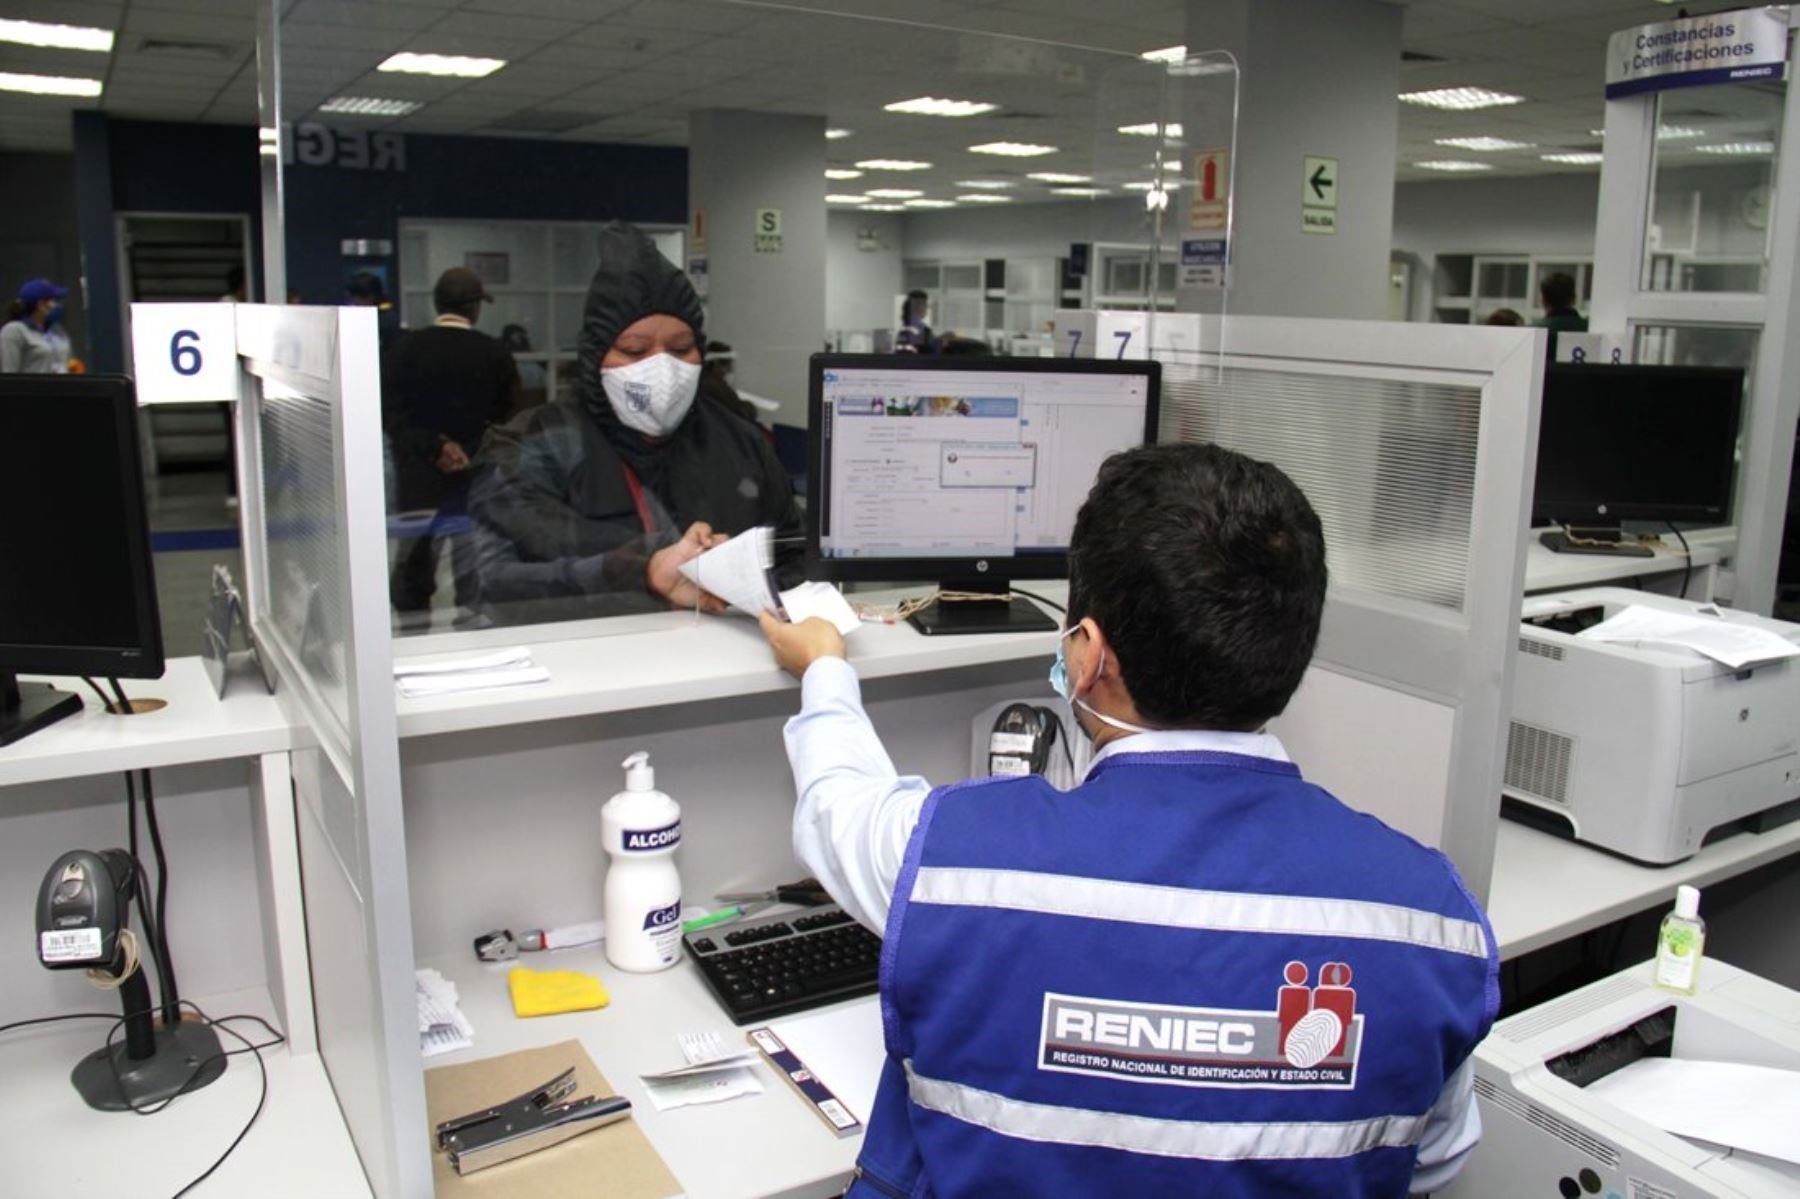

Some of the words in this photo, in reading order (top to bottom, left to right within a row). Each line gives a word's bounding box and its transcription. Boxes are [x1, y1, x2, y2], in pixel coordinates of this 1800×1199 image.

[1636, 23, 1736, 49] Constancias
[1623, 60, 1630, 75] y
[1633, 42, 1755, 70] Certificaciones
[762, 212, 776, 232] S
[170, 329, 203, 376] 6
[1067, 330, 1083, 359] 7
[1113, 331, 1132, 360] 7
[653, 906, 676, 924] Gel
[1055, 1006, 1255, 1055] RENIEC
[1053, 1050, 1109, 1067] REGISTRO
[1111, 1059, 1167, 1074] NACIONAL
[1170, 1064, 1185, 1075] DE
[1187, 1065, 1268, 1079] IDENTIFICACIÓN
[1271, 1070, 1279, 1079] Y
[1280, 1069, 1317, 1080] ESTADO
[1320, 1070, 1345, 1080] CIVIL
